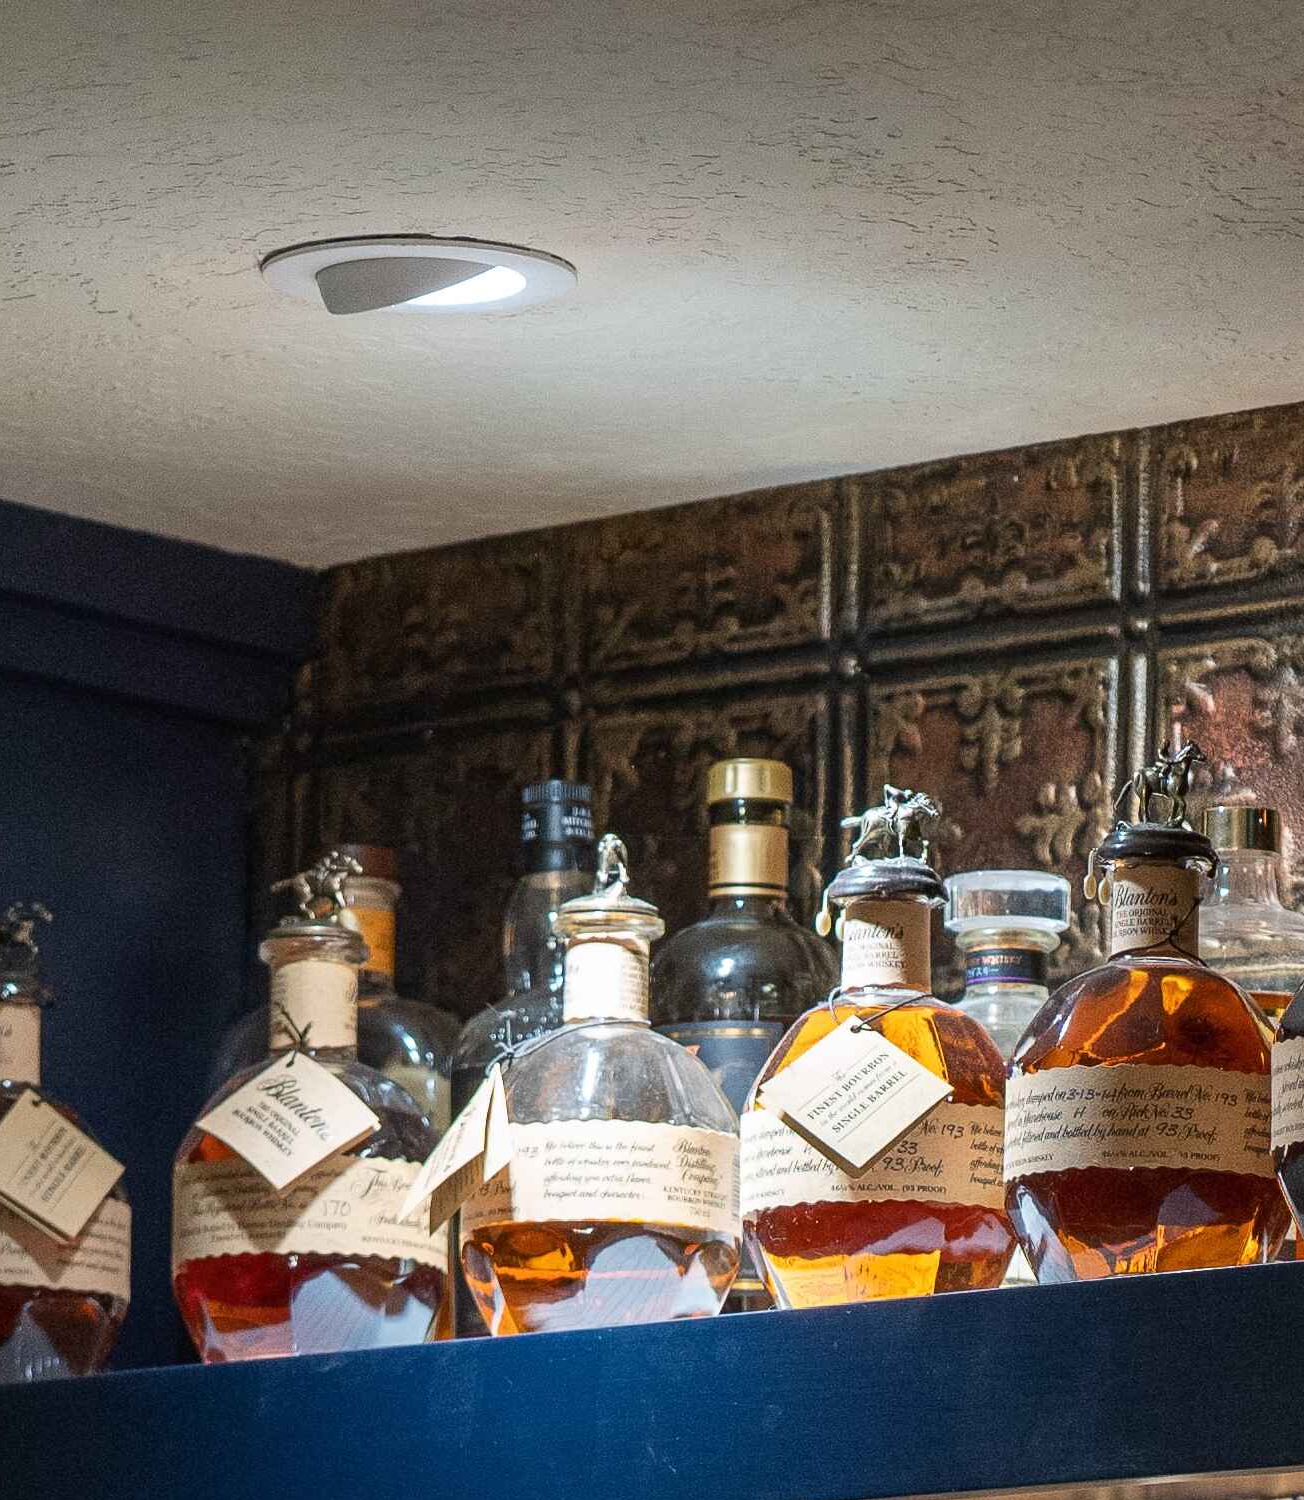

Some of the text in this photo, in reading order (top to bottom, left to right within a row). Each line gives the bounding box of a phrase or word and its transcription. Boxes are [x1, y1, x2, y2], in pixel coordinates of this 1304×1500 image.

[809, 1050, 890, 1121] FINEST BOURBON
[831, 1069, 909, 1134] SINGLE BARREL
[1213, 1092, 1239, 1107] 193
[1073, 1106, 1087, 1119] H
